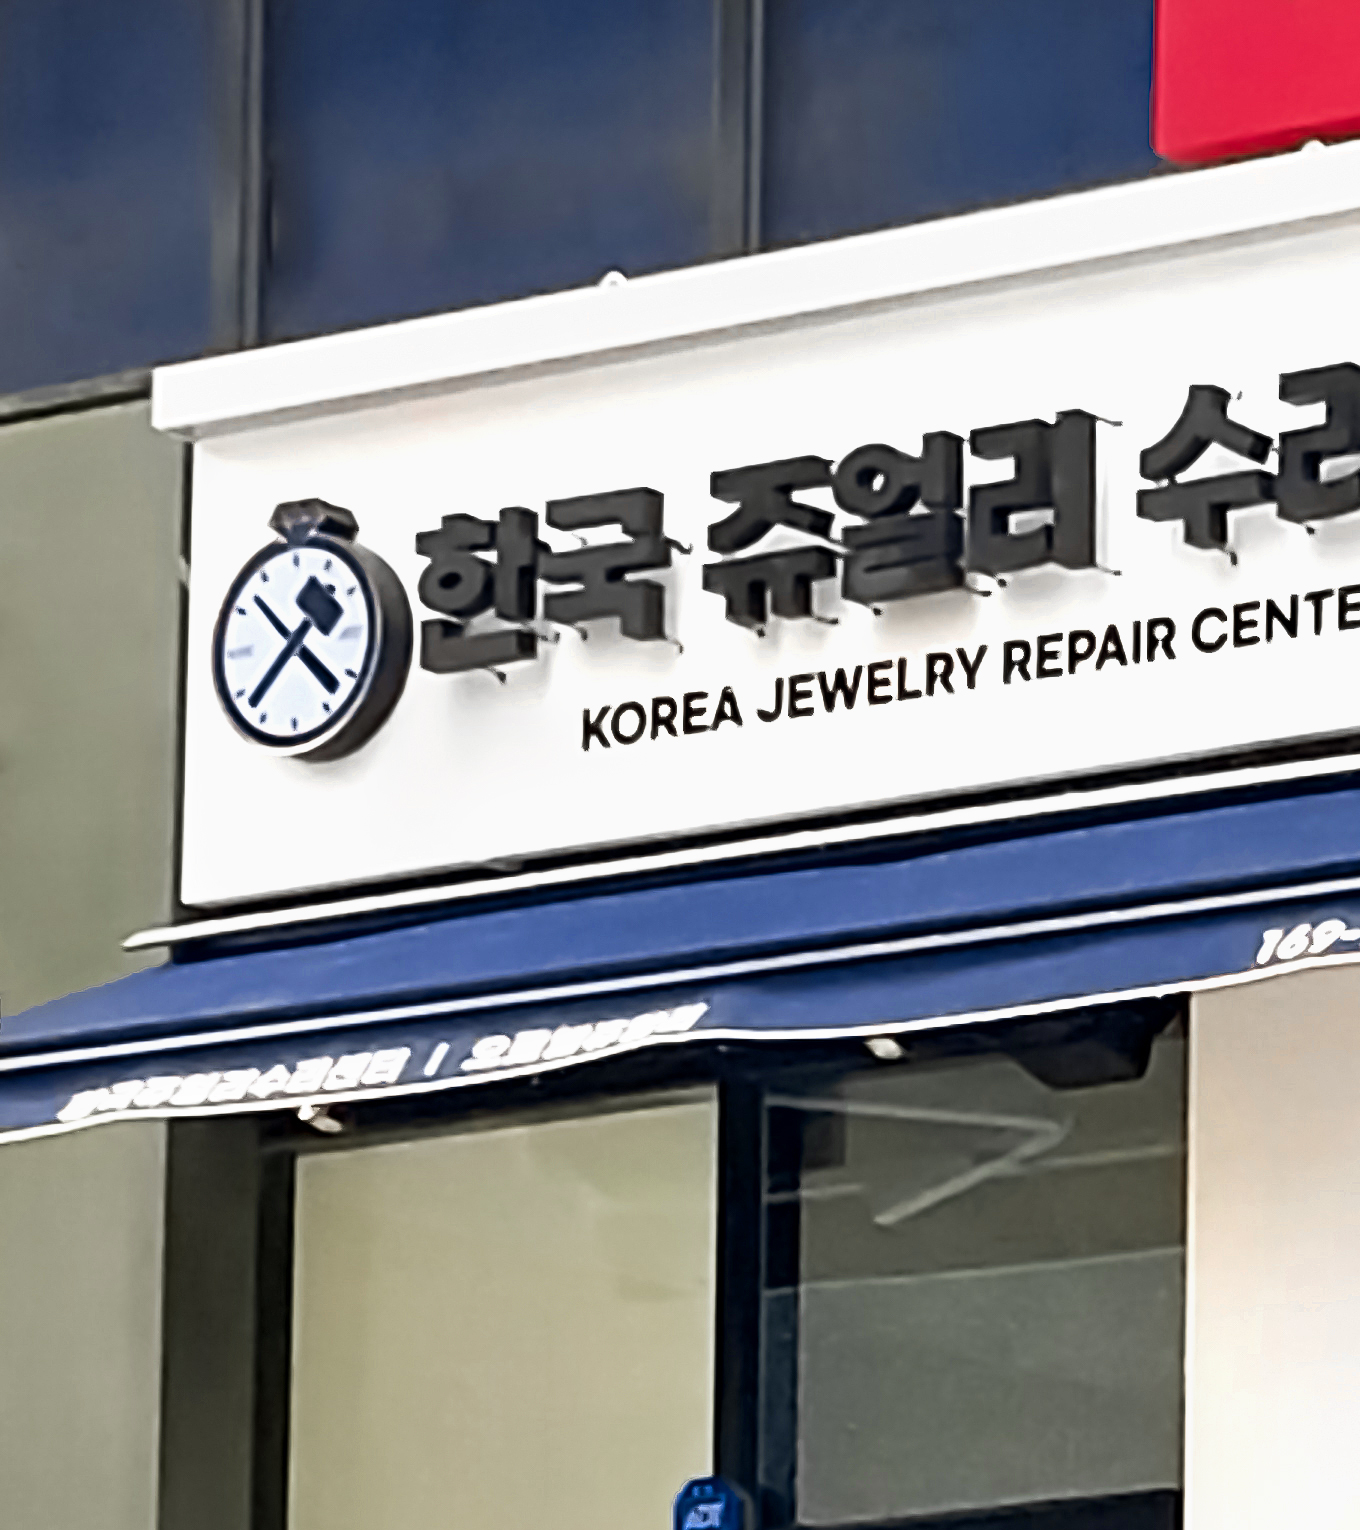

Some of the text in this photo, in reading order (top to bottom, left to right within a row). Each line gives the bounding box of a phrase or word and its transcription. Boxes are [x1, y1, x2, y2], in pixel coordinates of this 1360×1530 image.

[418, 487, 691, 683] 한국
[703, 409, 1122, 628] 쥬얼리
[582, 686, 742, 751] KOREA
[757, 645, 987, 722] JEWELRY
[1003, 618, 1175, 684] REPAIR
